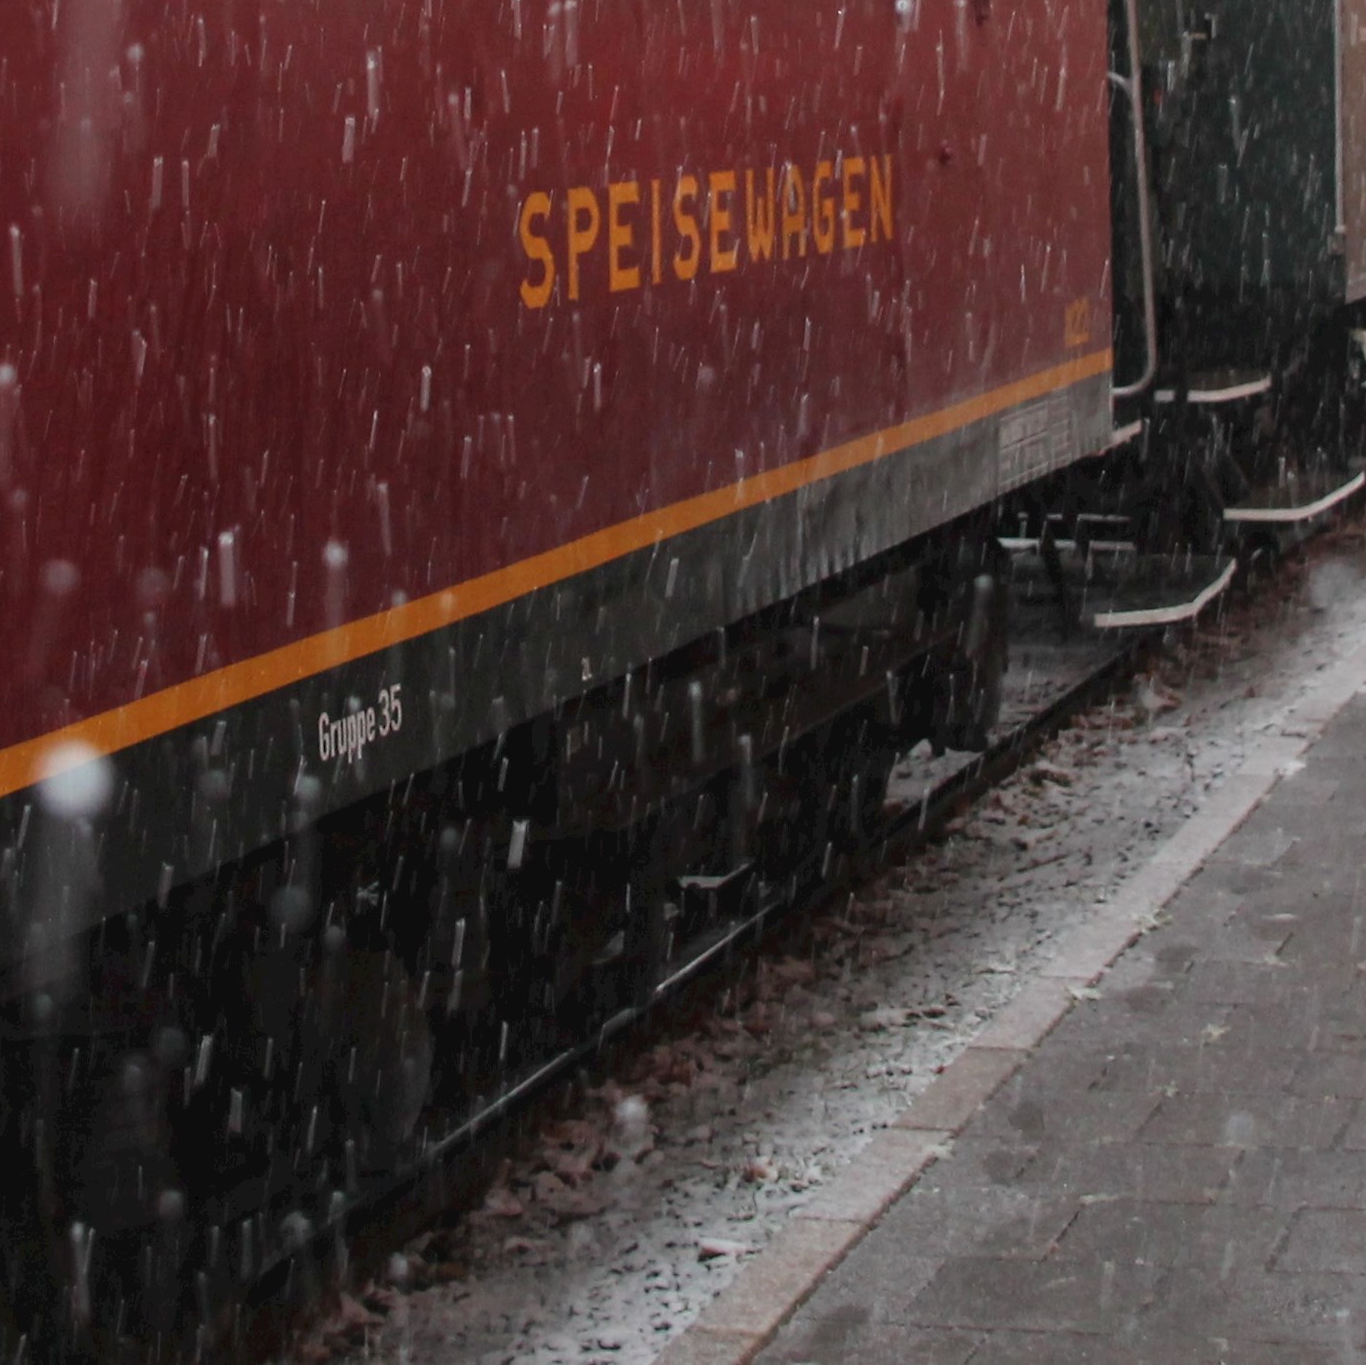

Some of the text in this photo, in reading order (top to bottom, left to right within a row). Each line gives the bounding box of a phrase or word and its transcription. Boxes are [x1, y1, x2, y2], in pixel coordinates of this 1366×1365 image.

[519, 153, 894, 309] SPEISEWAGEN
[318, 683, 403, 764] Gruppe 35
